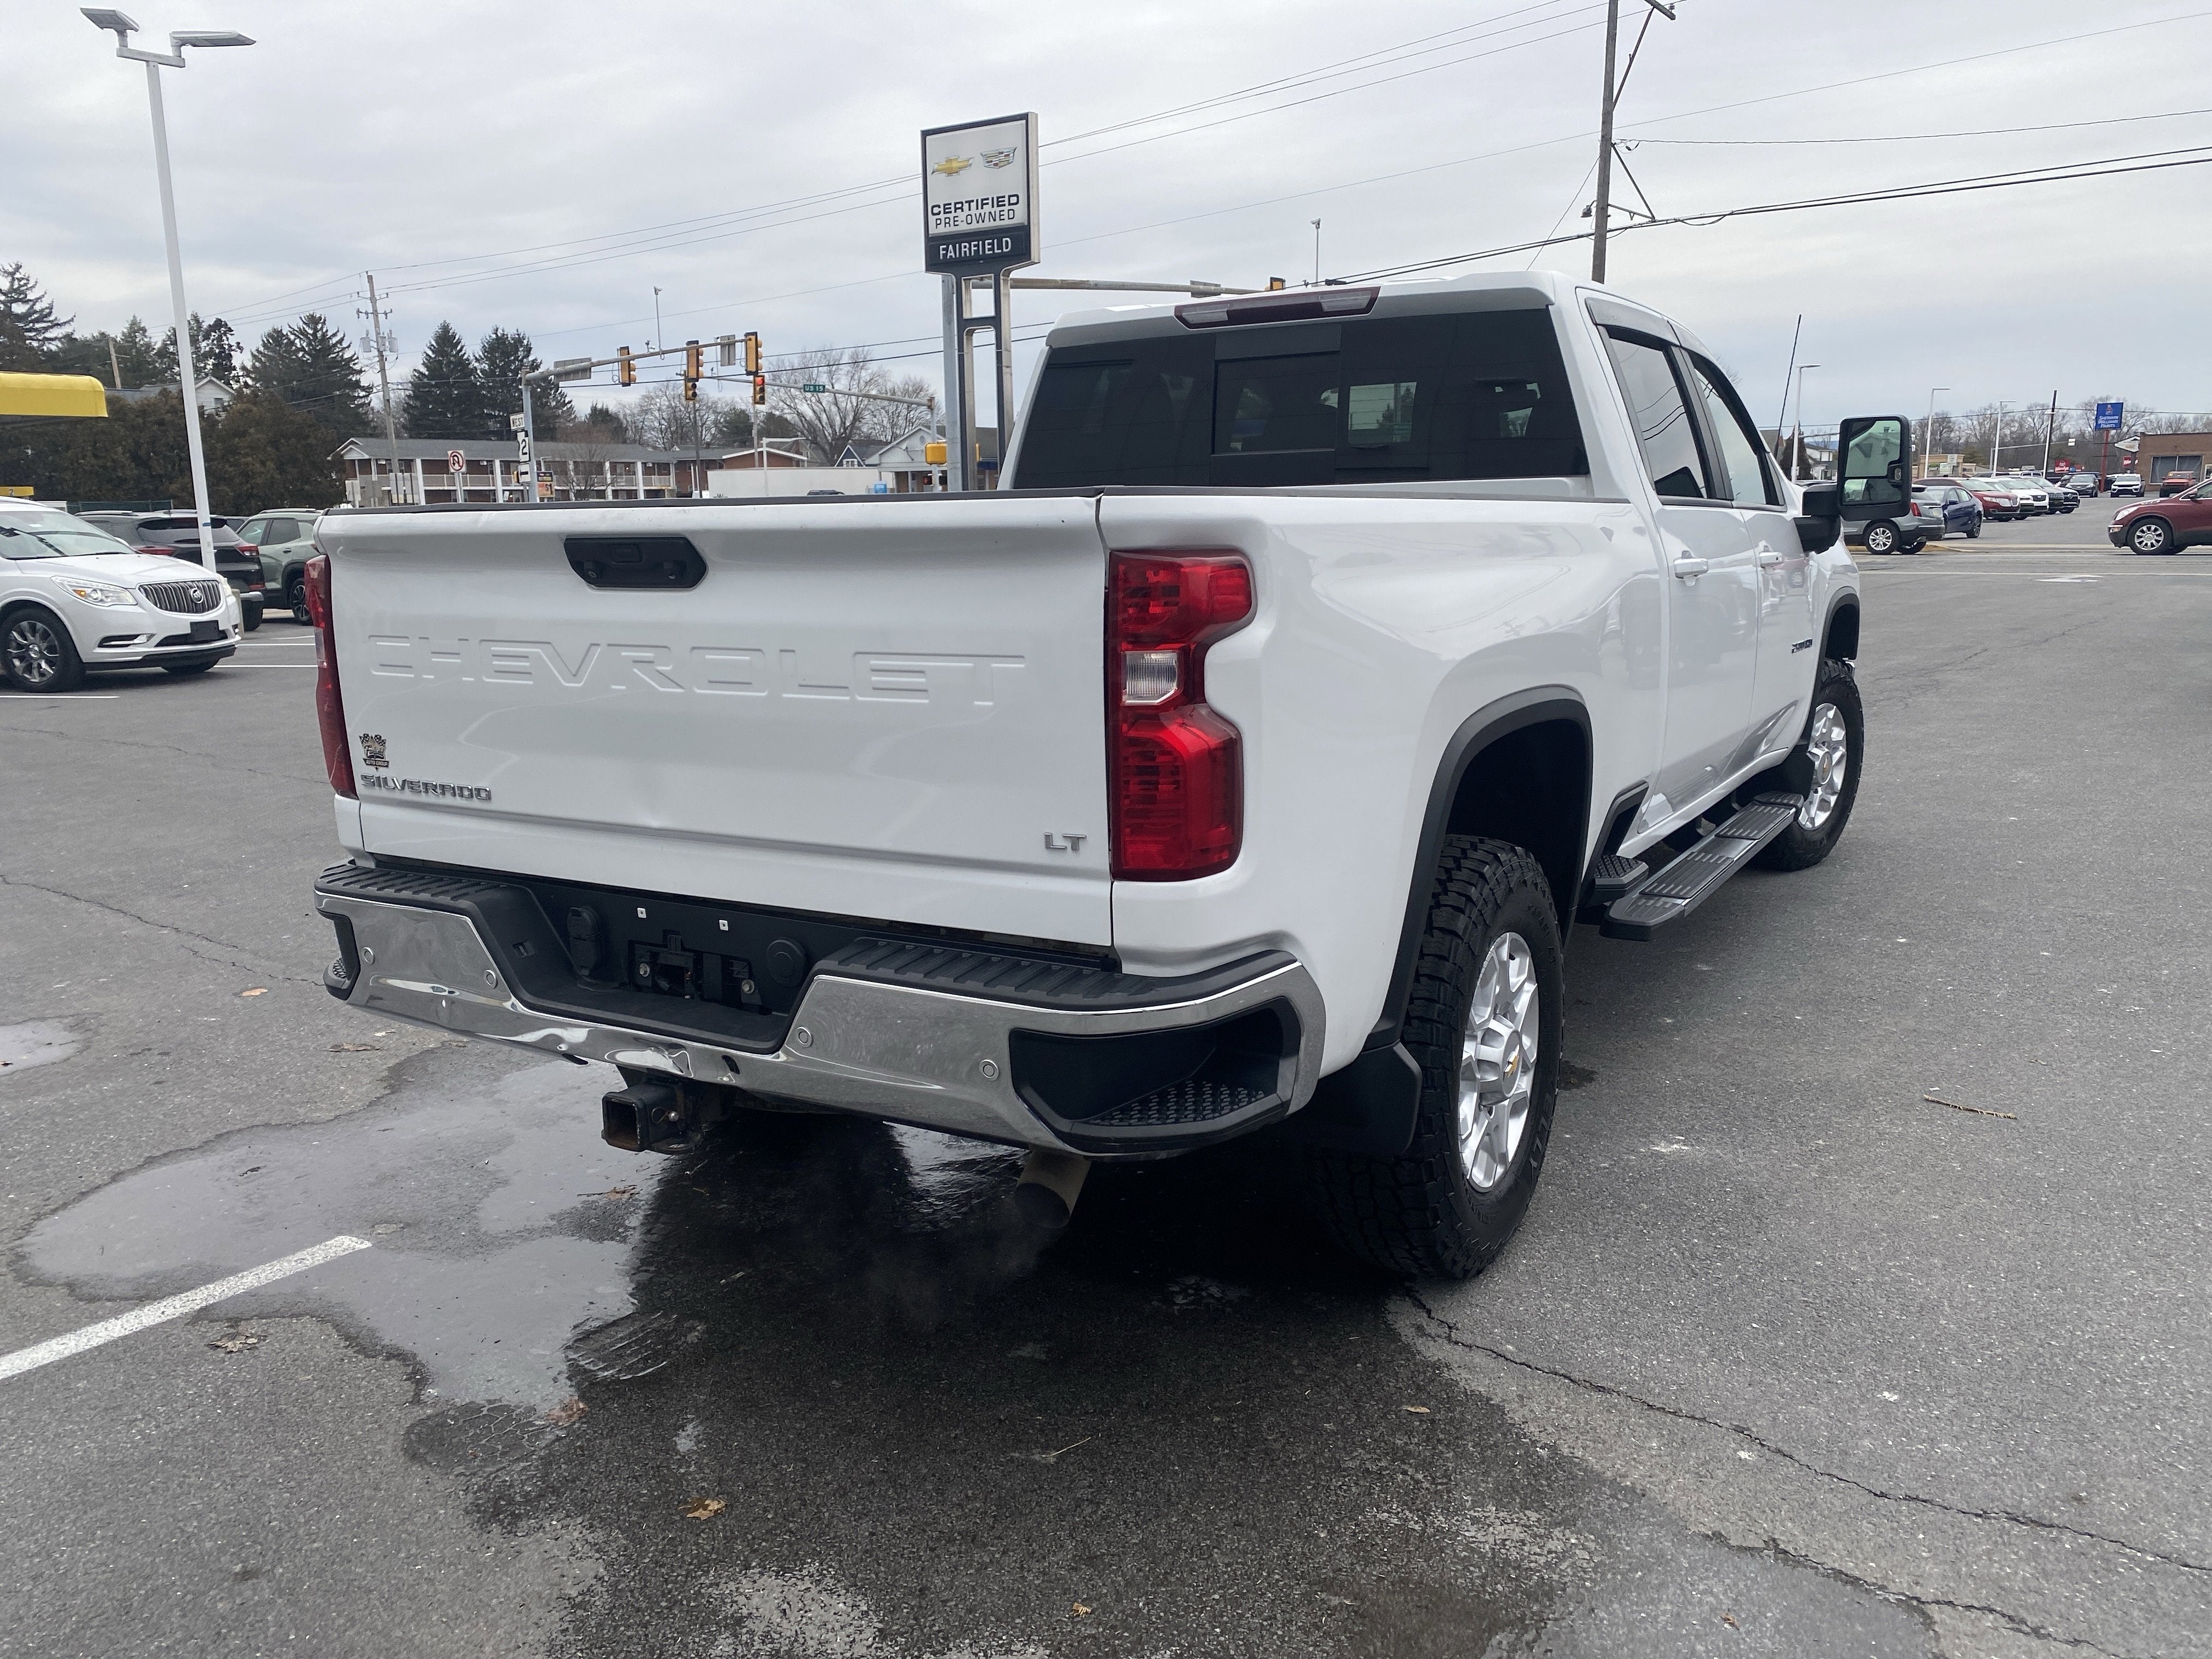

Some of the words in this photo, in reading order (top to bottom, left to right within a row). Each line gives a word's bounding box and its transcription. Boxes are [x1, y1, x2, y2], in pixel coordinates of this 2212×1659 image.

[931, 194, 1019, 216] CERTIFIED
[935, 208, 1015, 229] PRE-OWNED
[939, 237, 1012, 260] FAIRFIELD
[511, 417, 523, 427] WEST
[9, 488, 14, 496] 2
[368, 634, 1025, 706] CHEVROLET
[360, 774, 492, 800] SILVERADO
[1044, 832, 1087, 851] LT
